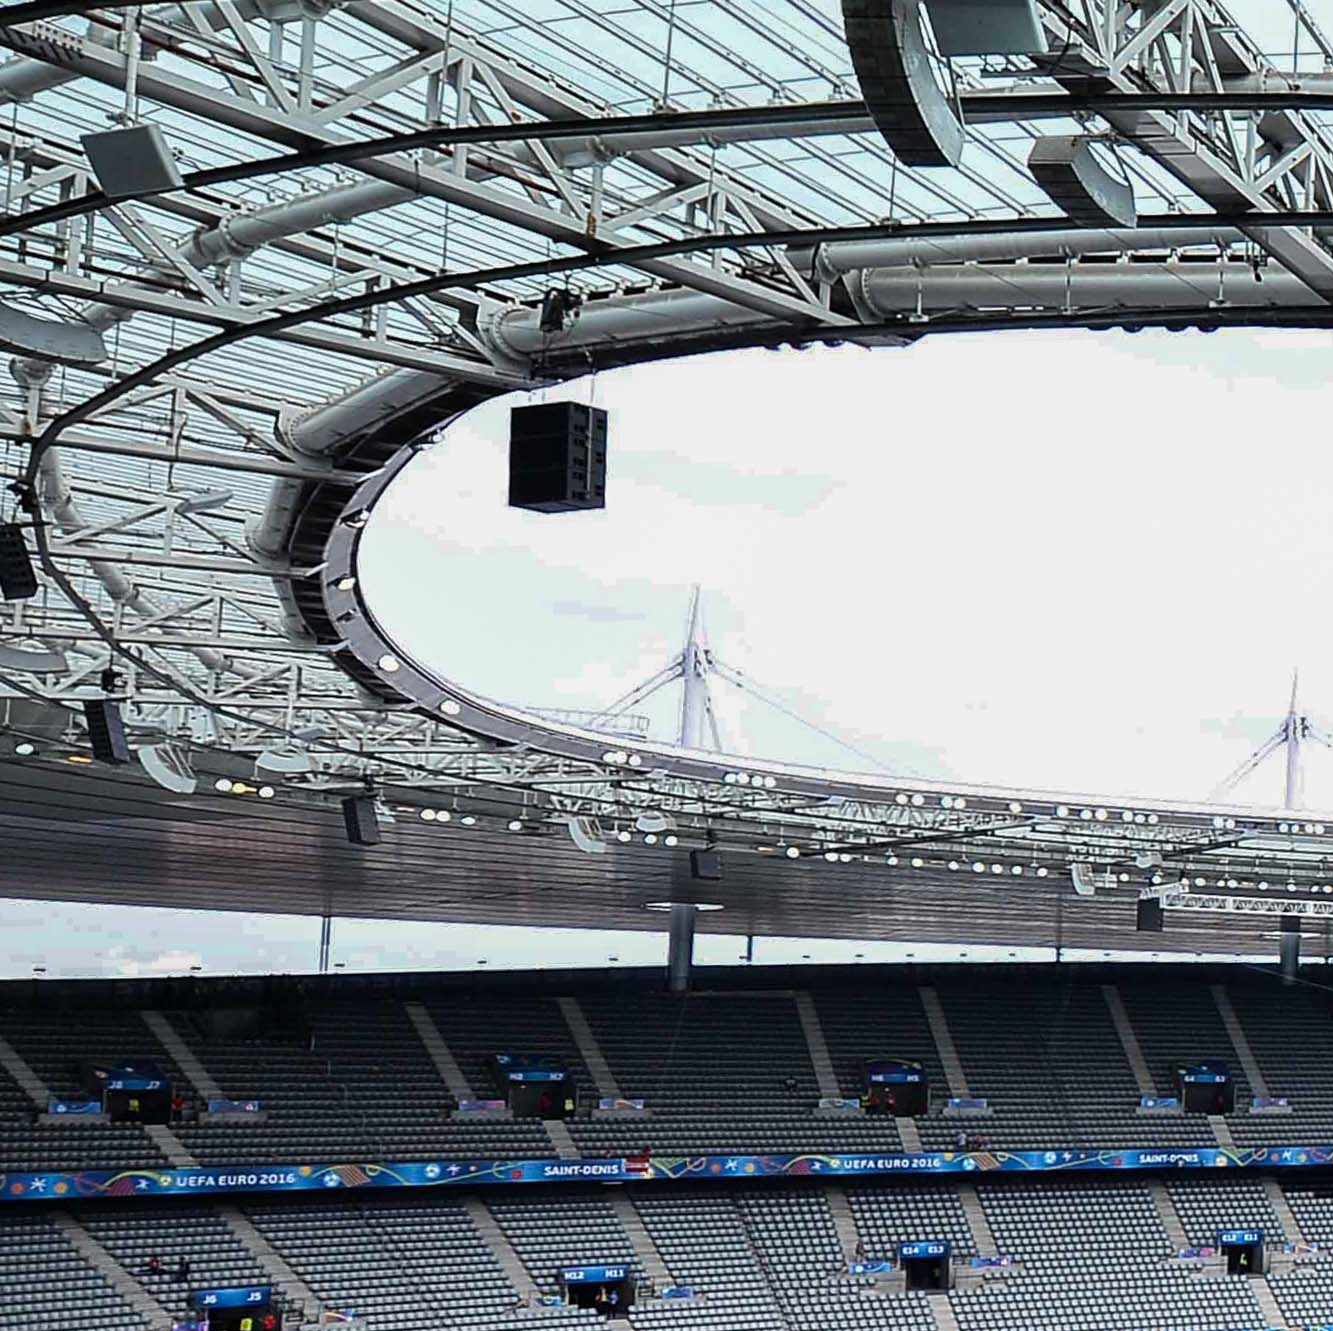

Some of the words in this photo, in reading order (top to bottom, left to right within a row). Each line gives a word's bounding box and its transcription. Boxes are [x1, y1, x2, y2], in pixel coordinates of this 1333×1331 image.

[844, 1159, 876, 1169] UEFA
[878, 1159, 909, 1169] EURO
[912, 1158, 940, 1168] 2016
[545, 1165, 620, 1176] SAINT-DENIS
[176, 1177, 215, 1187] UEFA
[218, 1175, 255, 1186] EURO
[260, 1173, 296, 1185] 2016
[564, 1271, 585, 1280] H12
[605, 1269, 624, 1278] H11
[203, 1295, 217, 1304] J6
[247, 1291, 262, 1302] J5
